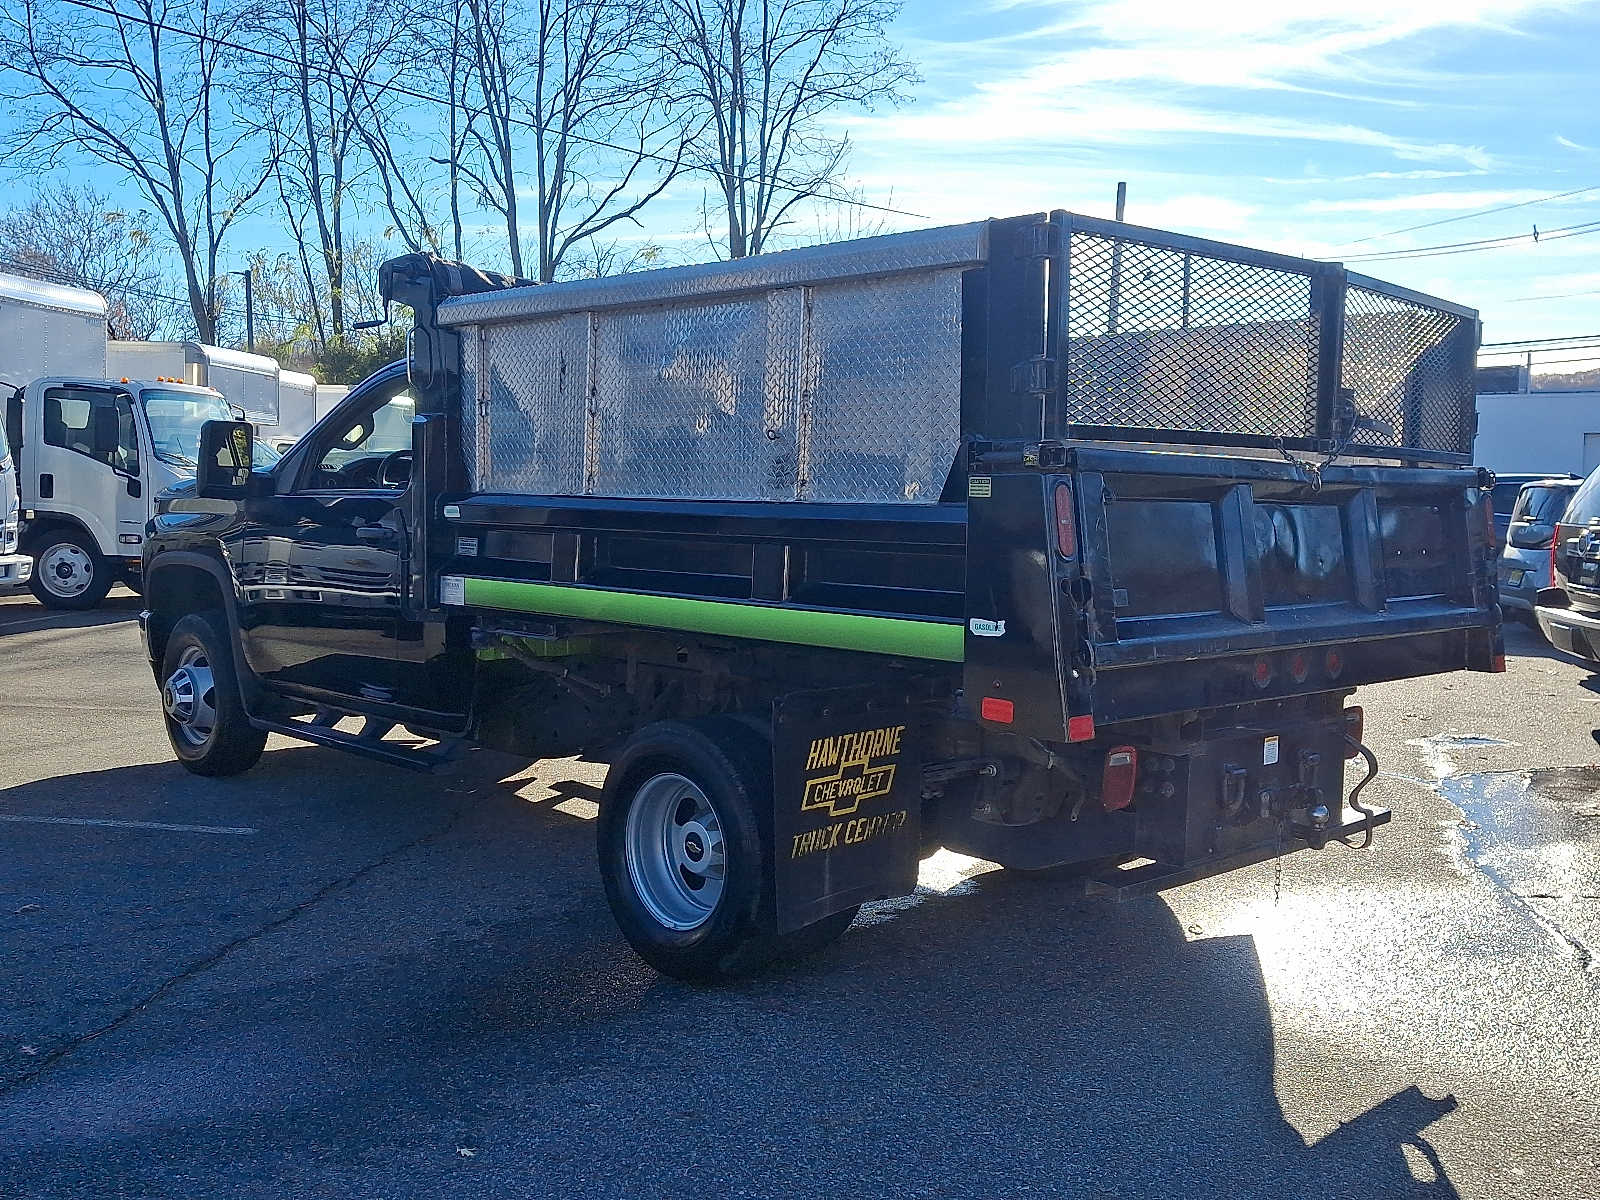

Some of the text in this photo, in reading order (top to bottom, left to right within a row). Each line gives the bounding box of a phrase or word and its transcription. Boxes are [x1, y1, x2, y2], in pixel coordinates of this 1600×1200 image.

[974, 623, 1002, 632] GASOLIE
[806, 725, 905, 771] HAWTHORNE
[814, 772, 884, 803] CHEVROLET
[791, 822, 843, 859] TRUCK
